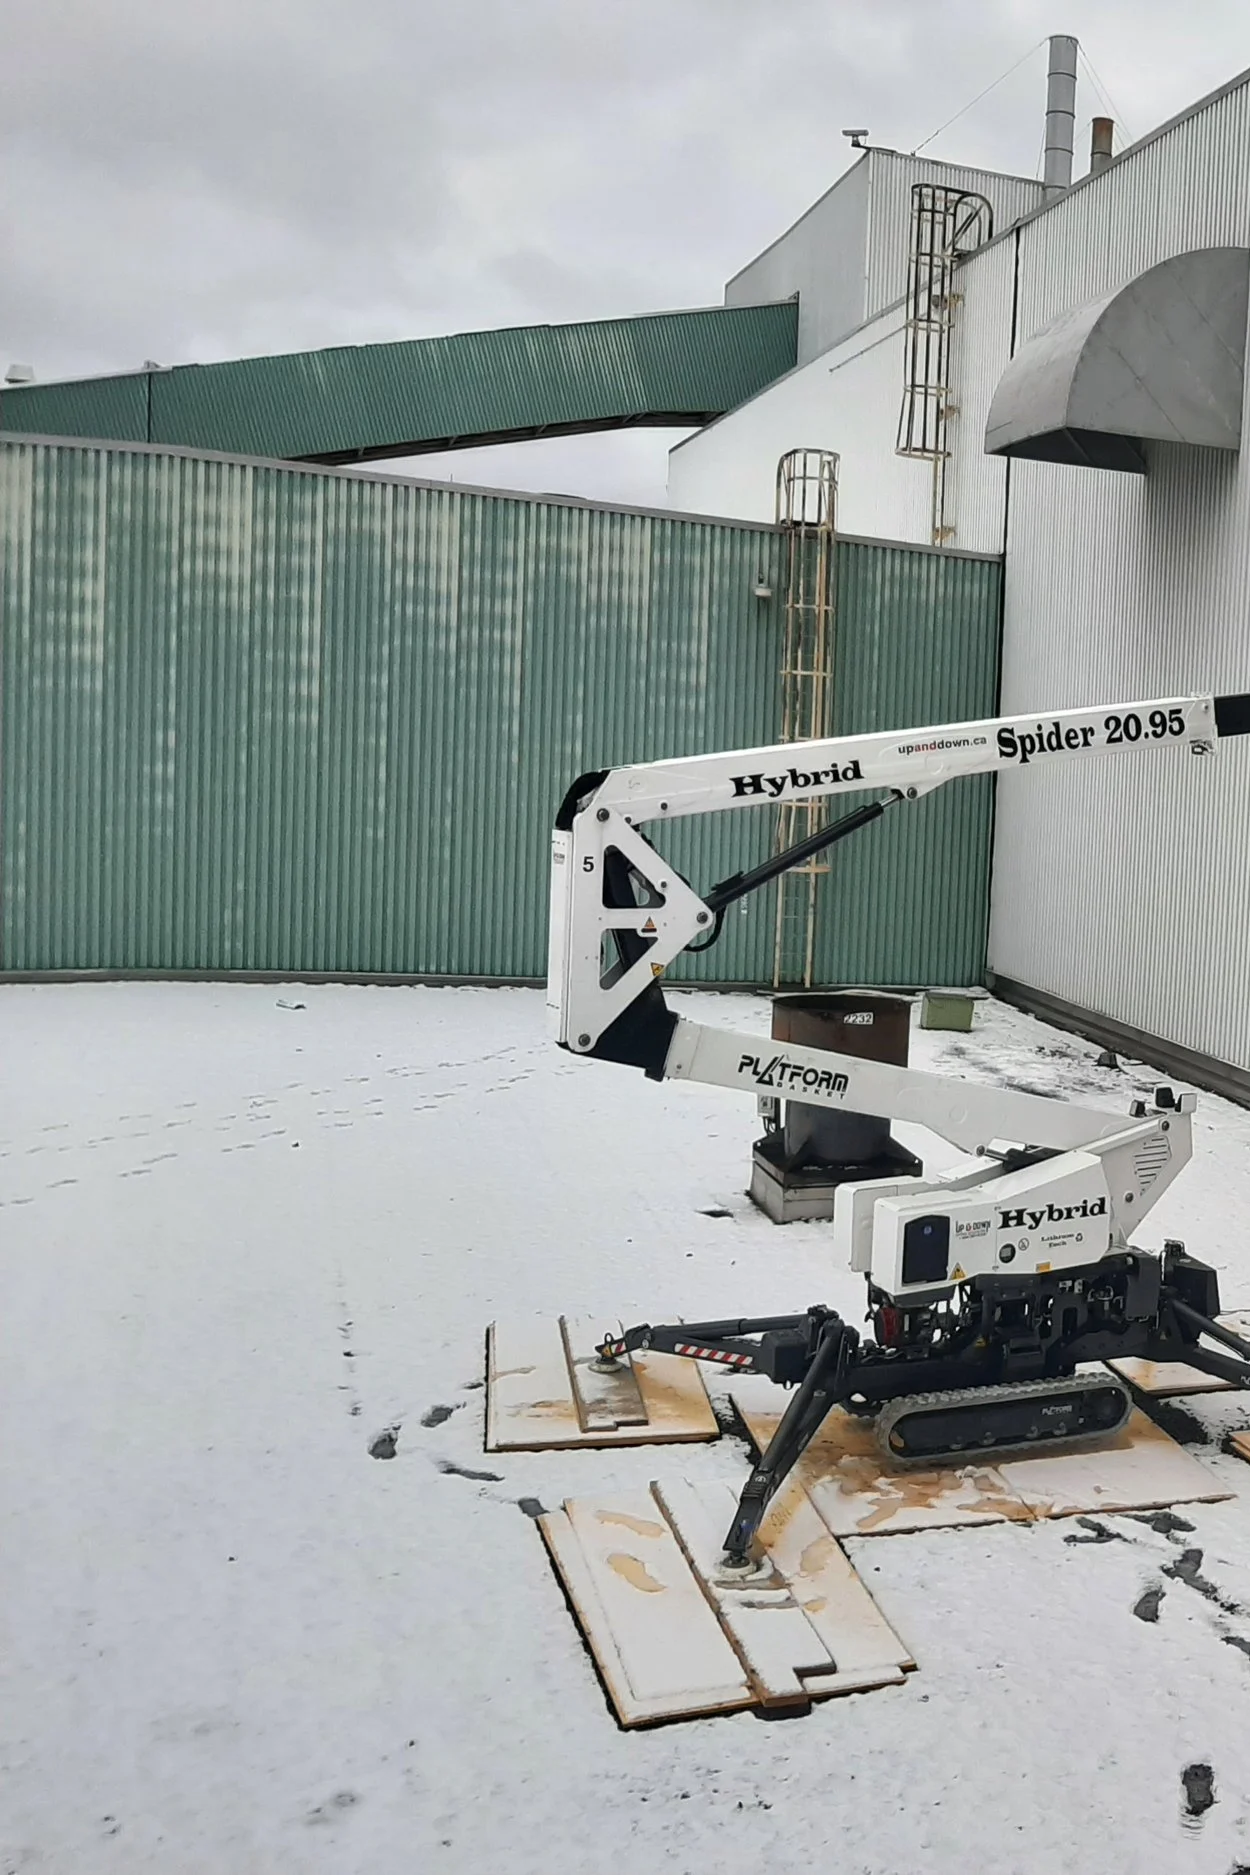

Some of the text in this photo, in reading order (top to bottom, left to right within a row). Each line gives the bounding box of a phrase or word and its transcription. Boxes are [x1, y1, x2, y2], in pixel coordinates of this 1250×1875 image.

[898, 737, 987, 755] upanddown.ca
[996, 708, 1185, 763] Spider 20.95
[729, 760, 864, 797] Hybrid
[583, 856, 594, 872] 5
[738, 1054, 849, 1093] PLATFORM
[998, 1196, 1108, 1230] Hybrid
